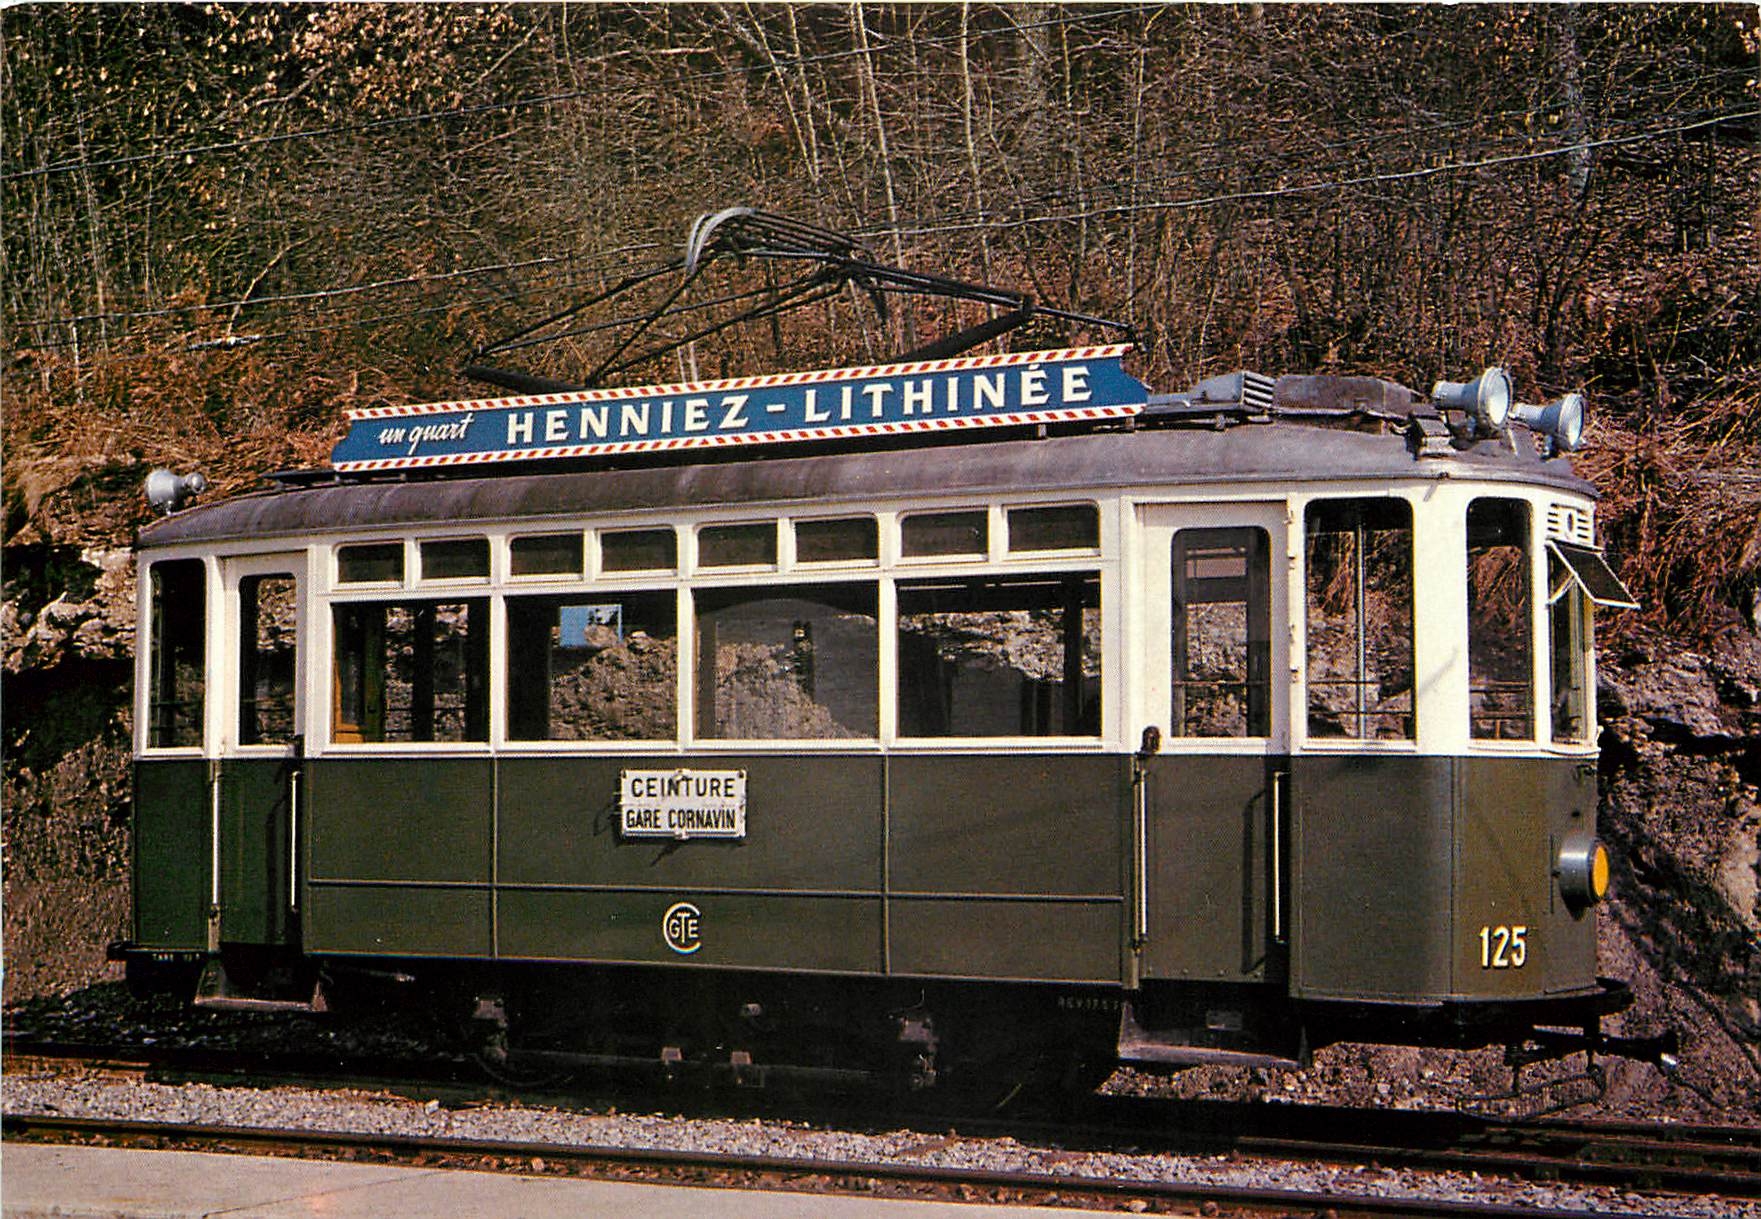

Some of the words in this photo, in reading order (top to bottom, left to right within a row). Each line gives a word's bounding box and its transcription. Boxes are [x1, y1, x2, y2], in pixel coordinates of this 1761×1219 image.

[379, 427, 406, 444] un
[408, 412, 475, 455] quart
[507, 395, 749, 444] HENNIEZ
[804, 364, 1093, 423] LITHINÉE
[631, 778, 736, 798] CEINTURE
[626, 809, 662, 829] GARE
[668, 809, 736, 829] CORNAVIN
[1479, 925, 1528, 969] 125
